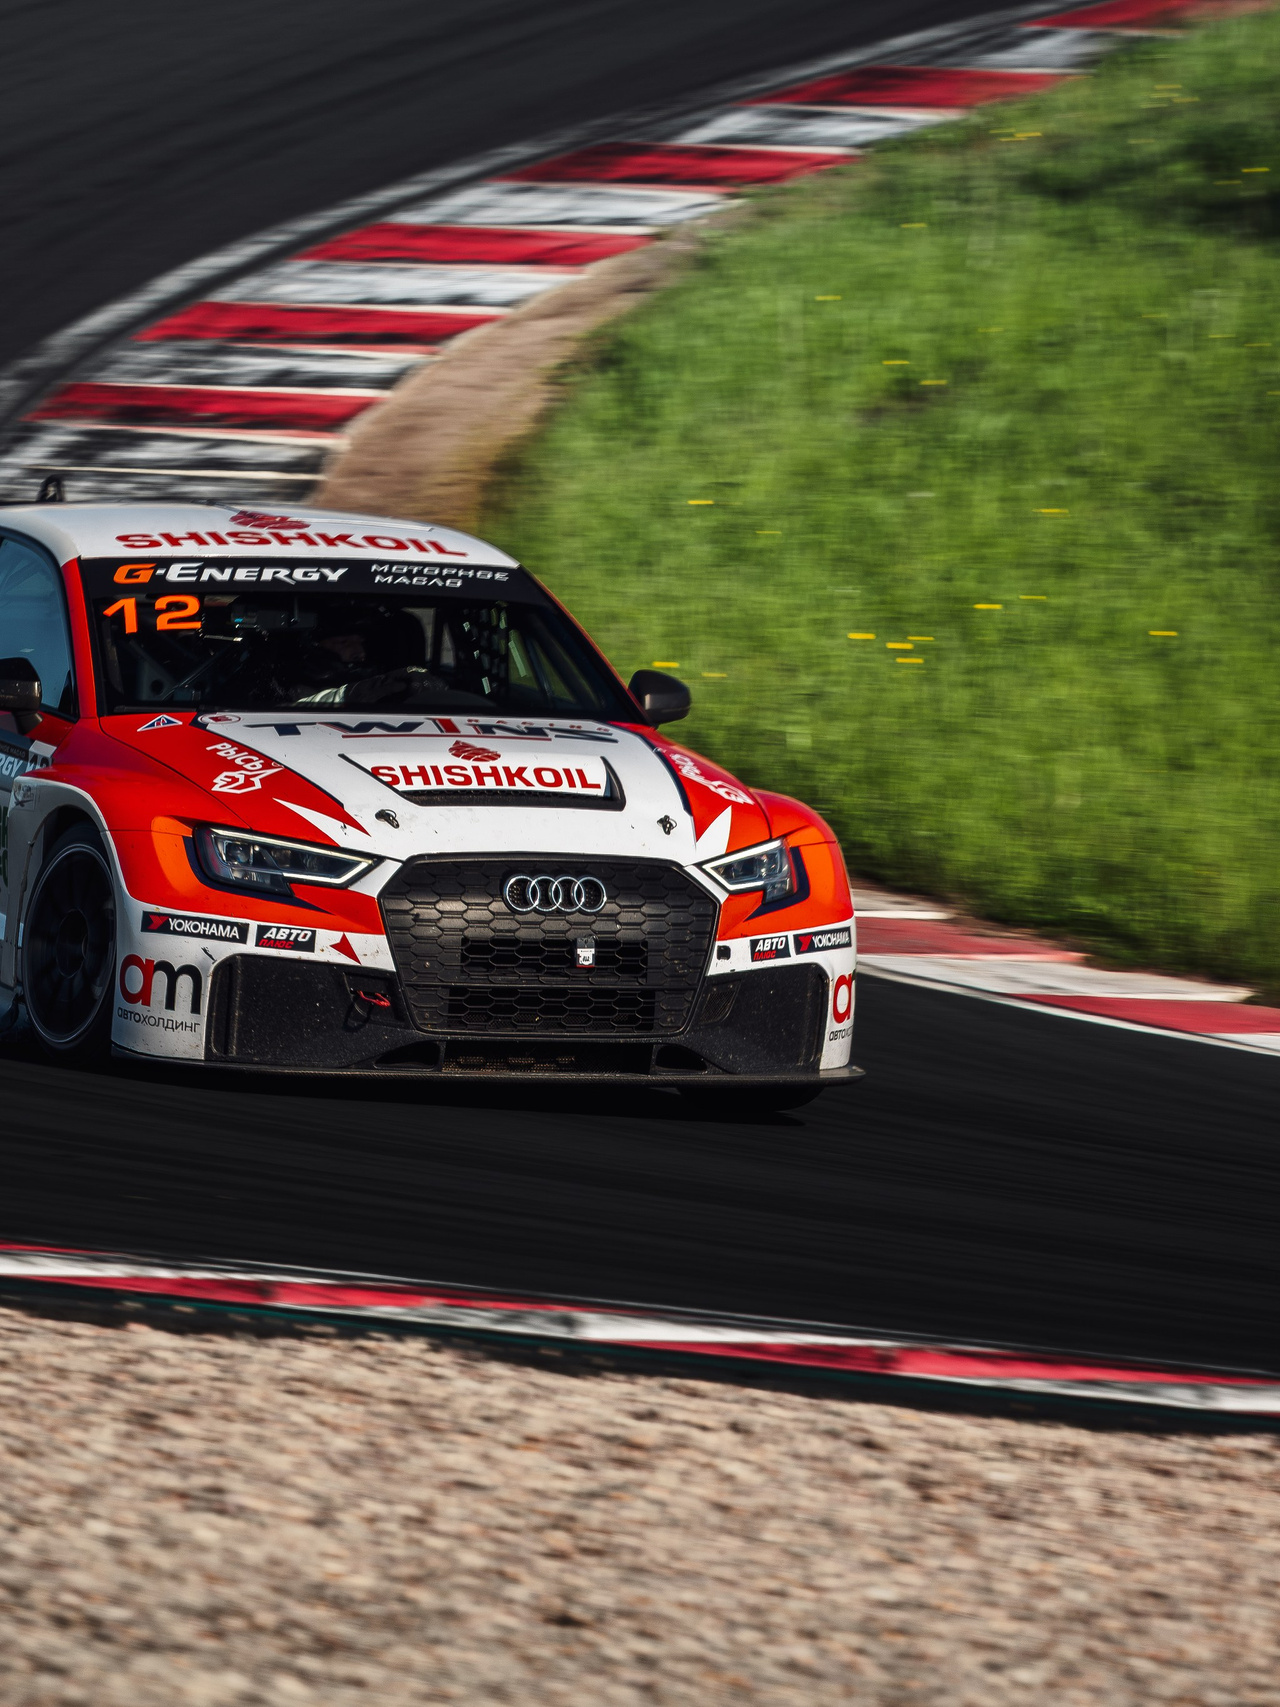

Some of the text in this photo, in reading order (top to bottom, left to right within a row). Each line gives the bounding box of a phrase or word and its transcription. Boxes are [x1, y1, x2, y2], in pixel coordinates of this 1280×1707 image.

[115, 530, 468, 557] SHISHKOIL
[370, 563, 509, 582] МОТОРНОЕ
[103, 594, 202, 634] 12
[369, 765, 602, 790] SHISHKOIL
[168, 918, 240, 940] YOKOHAMA
[263, 927, 312, 942] АВТО
[812, 930, 850, 948] YOKOHAMA
[258, 938, 294, 949] ПЛЮС
[755, 937, 786, 952] АВТО
[117, 1007, 200, 1033] автохолдинг
